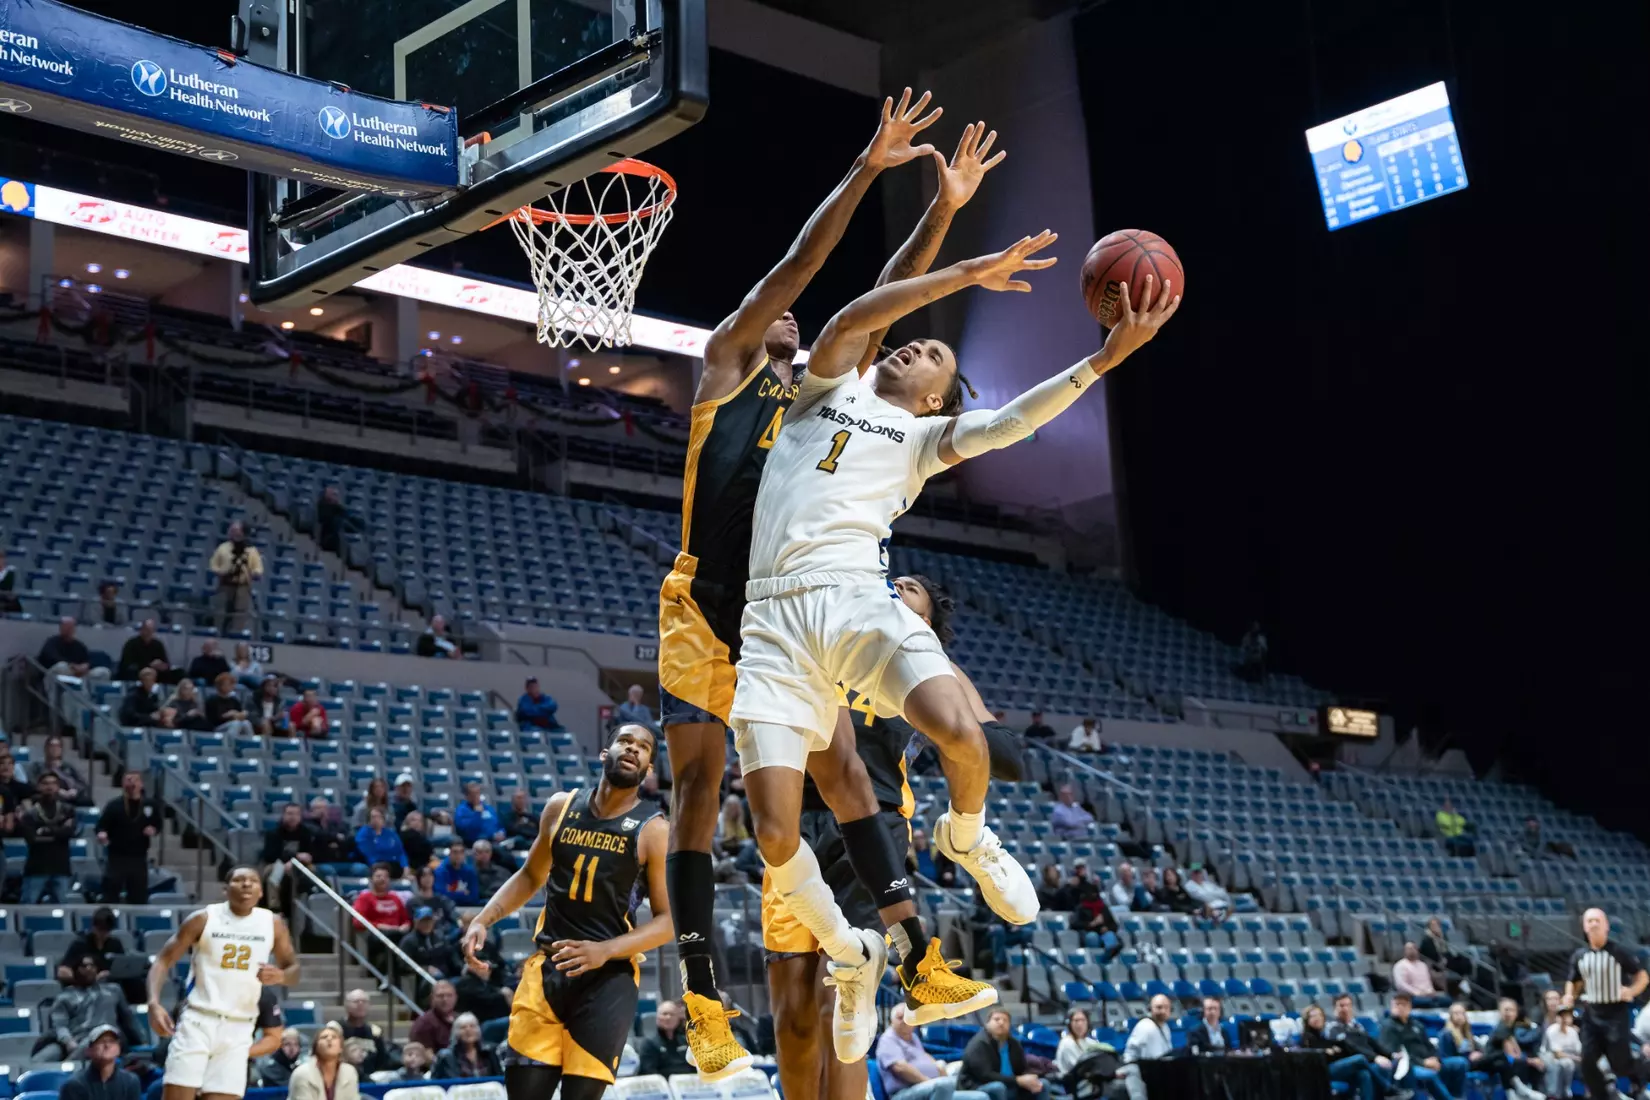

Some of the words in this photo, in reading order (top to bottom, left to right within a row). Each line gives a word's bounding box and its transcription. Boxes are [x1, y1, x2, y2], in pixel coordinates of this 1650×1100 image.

[10, 49, 74, 76] Network
[169, 68, 239, 99] Lutheran
[170, 87, 214, 110] Health
[215, 100, 271, 123] Network
[352, 112, 418, 136] Lutheran
[354, 130, 395, 148] Health
[396, 137, 447, 157] Network
[123, 209, 167, 226] AUTO
[118, 222, 181, 242] CENTER
[816, 429, 852, 475] 1
[560, 827, 628, 854] COMMERCE
[569, 853, 600, 903] 11
[220, 943, 252, 970] 22
